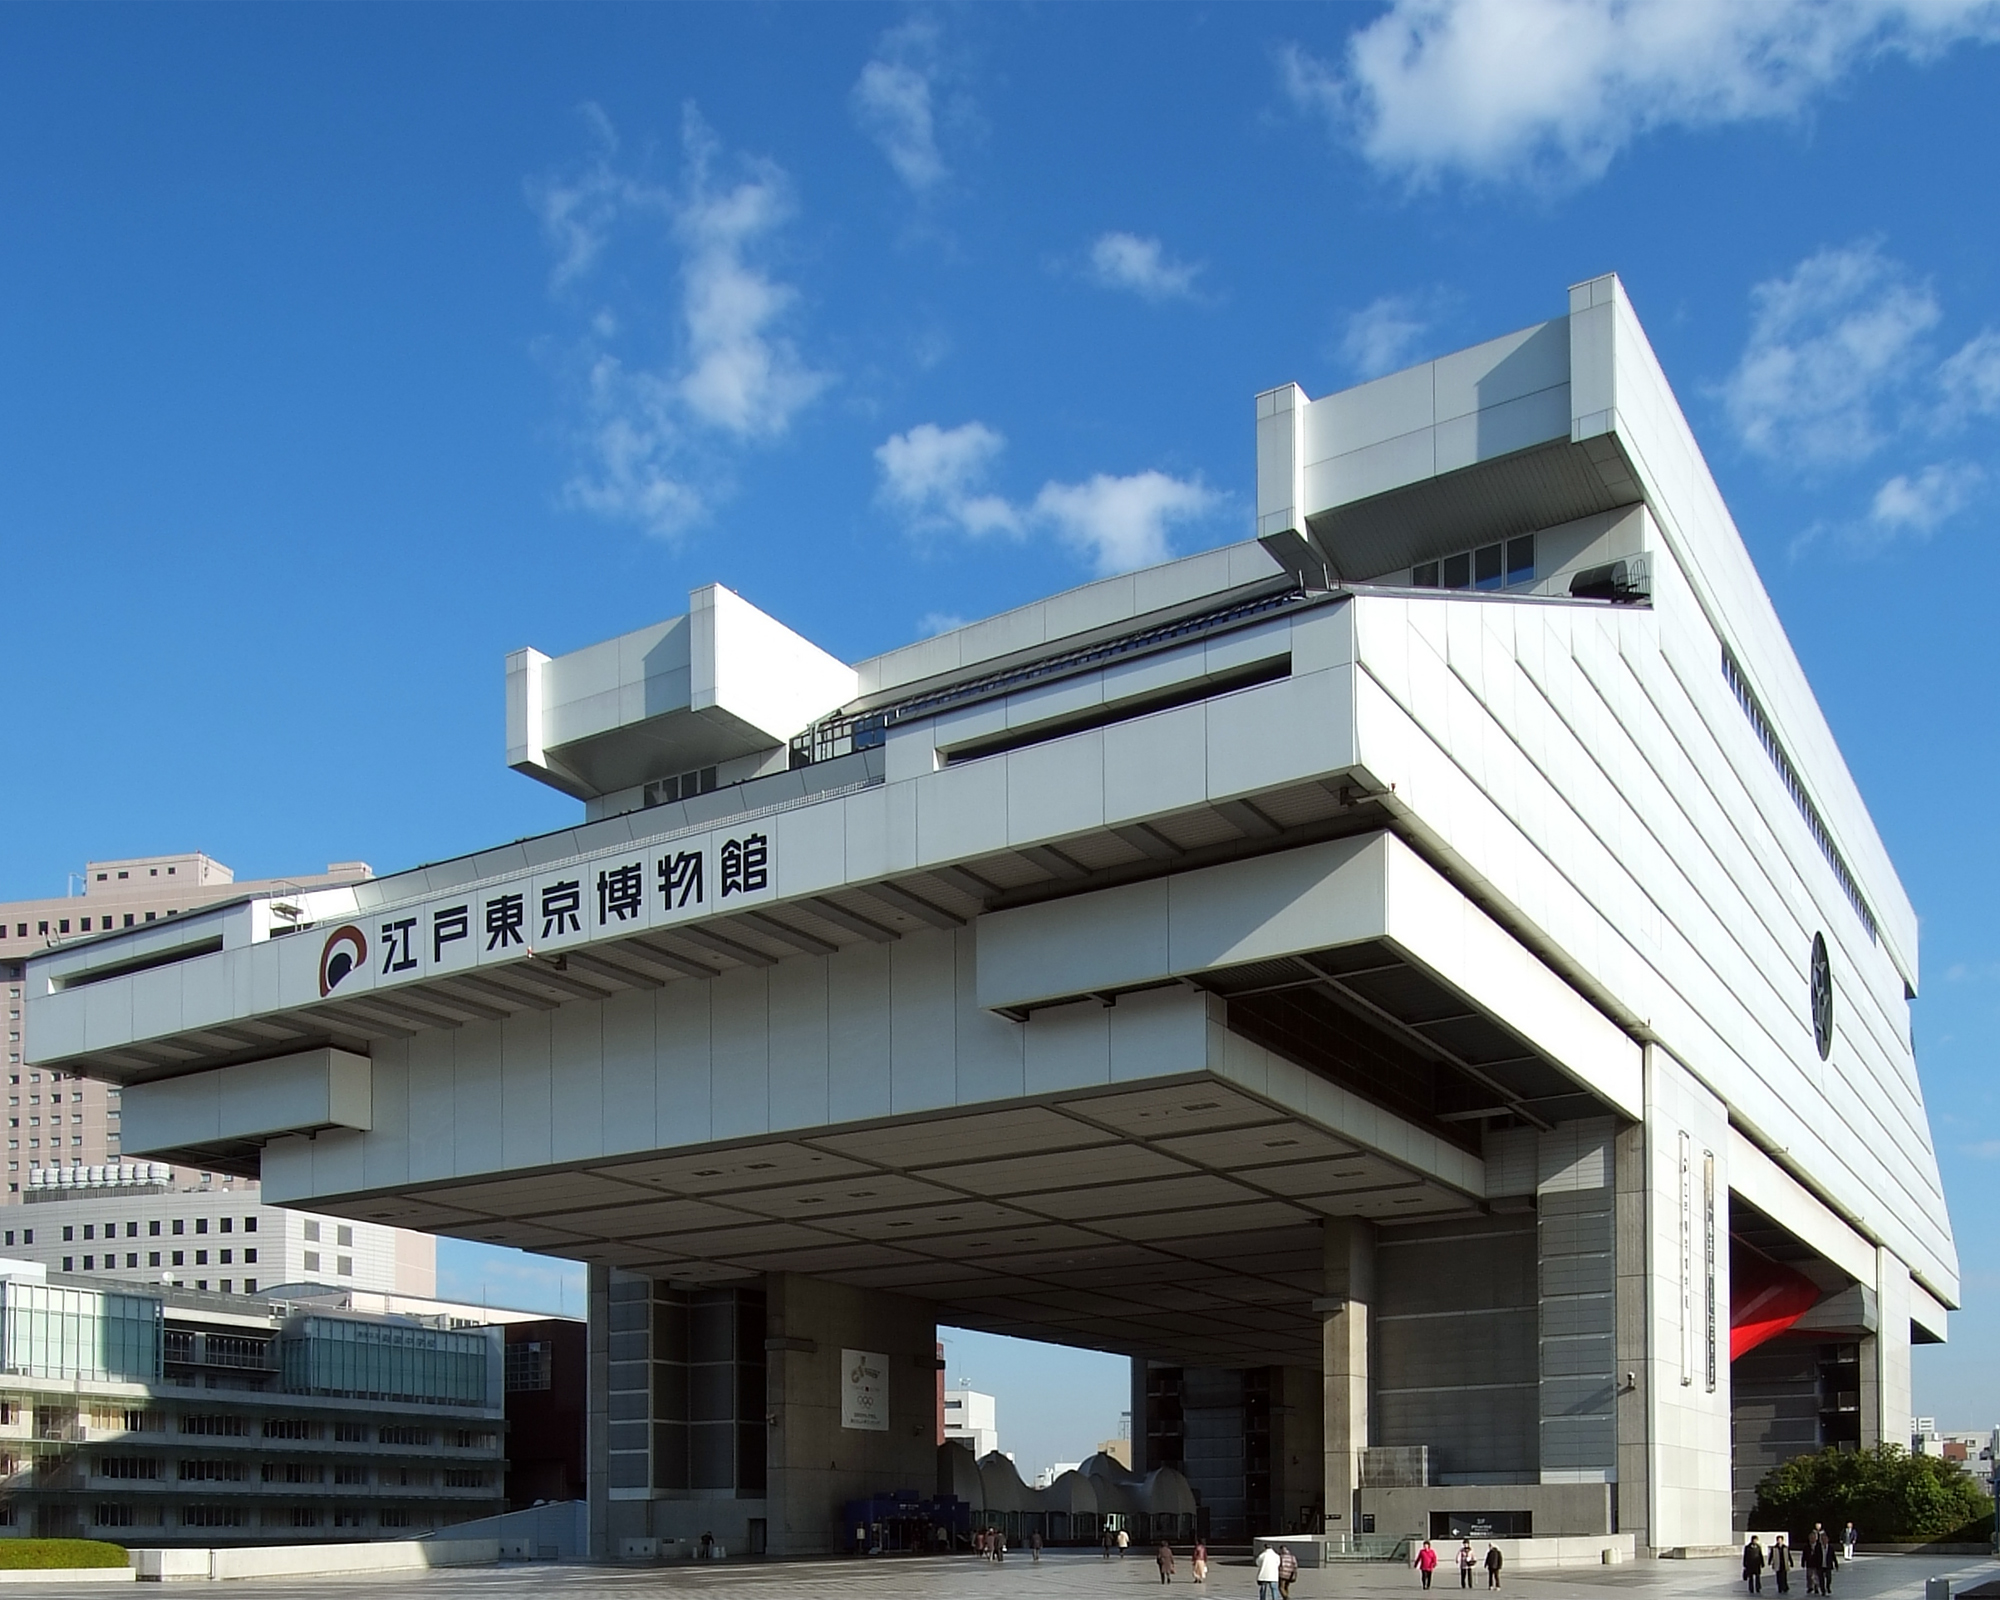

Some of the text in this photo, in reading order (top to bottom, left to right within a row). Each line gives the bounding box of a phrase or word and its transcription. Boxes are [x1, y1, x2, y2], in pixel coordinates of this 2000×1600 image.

[381, 832, 768, 974] 江戸東京博物館
